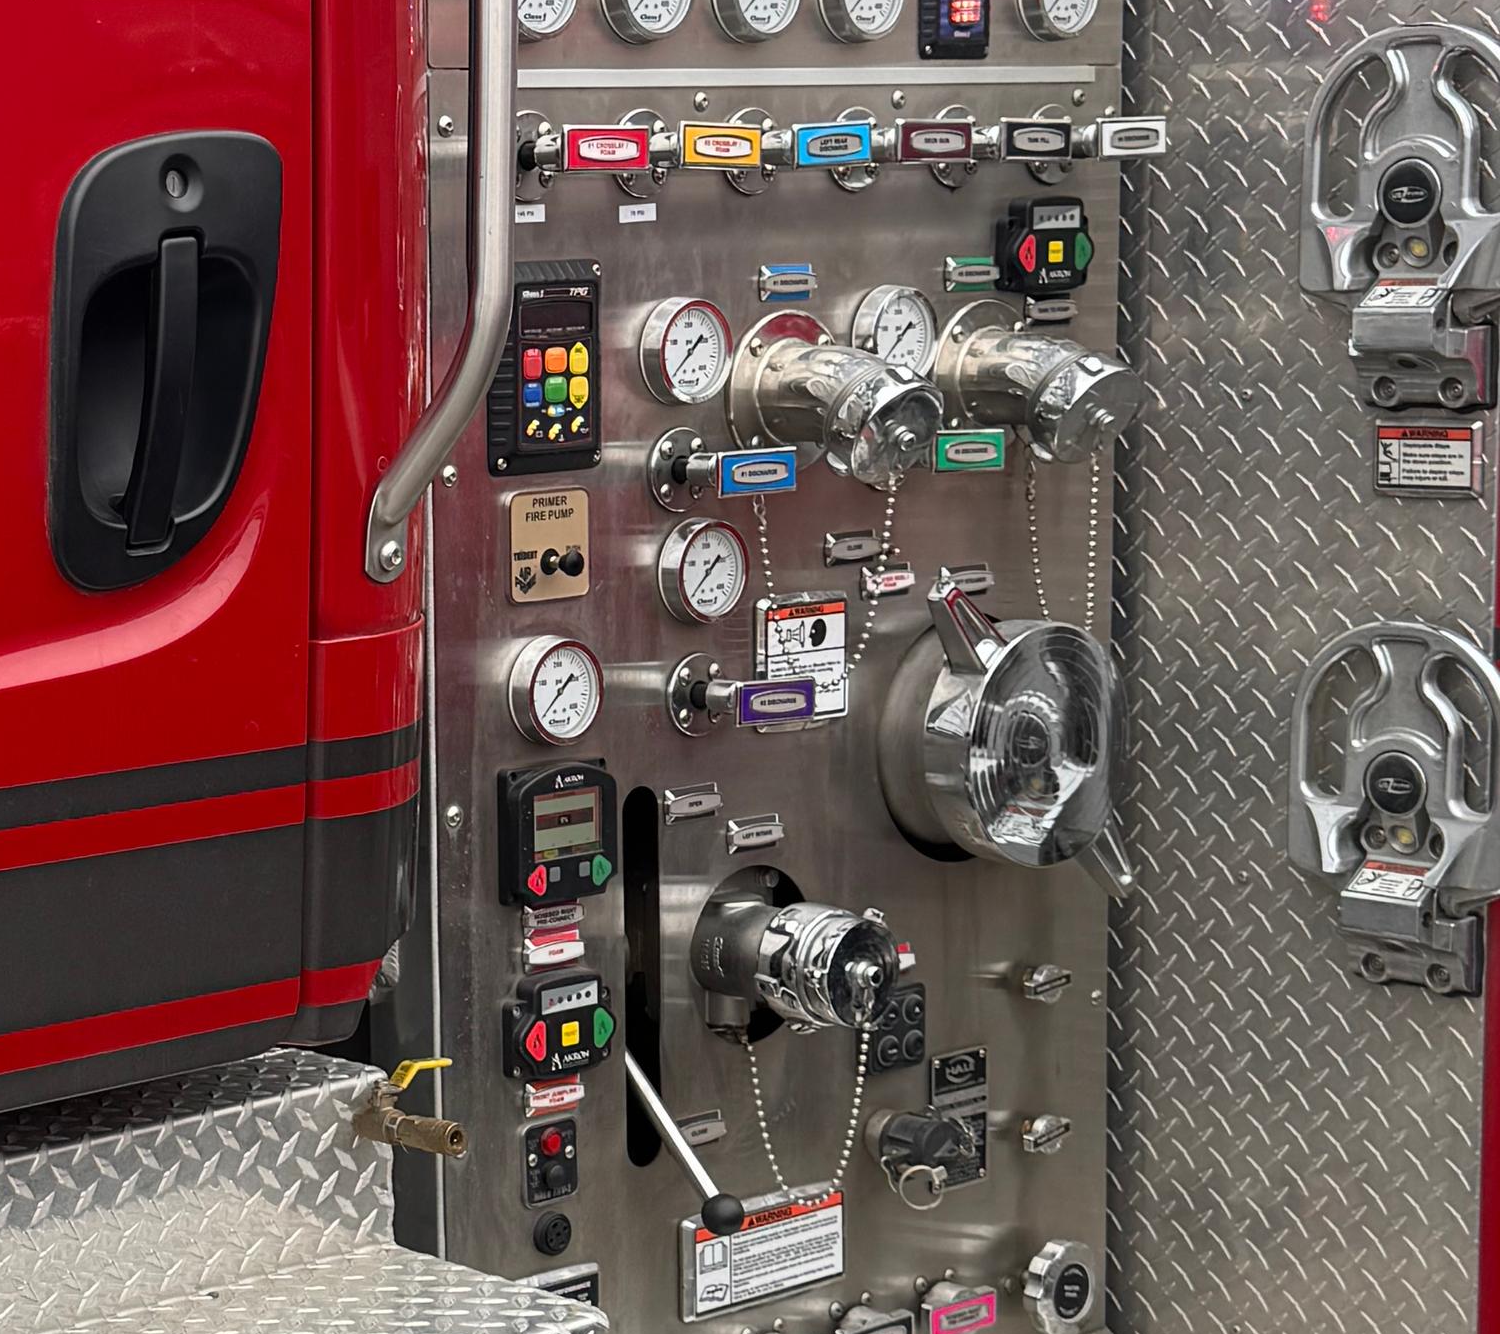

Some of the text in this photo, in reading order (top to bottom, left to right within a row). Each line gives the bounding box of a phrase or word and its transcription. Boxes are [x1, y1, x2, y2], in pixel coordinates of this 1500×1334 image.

[569, 286, 589, 296] TPG
[532, 495, 567, 508] PRIMER
[525, 508, 574, 522] FIRE PUMP
[513, 550, 538, 562] TRIDENT
[795, 605, 825, 615] WARNING
[755, 1207, 793, 1226] WARNING
